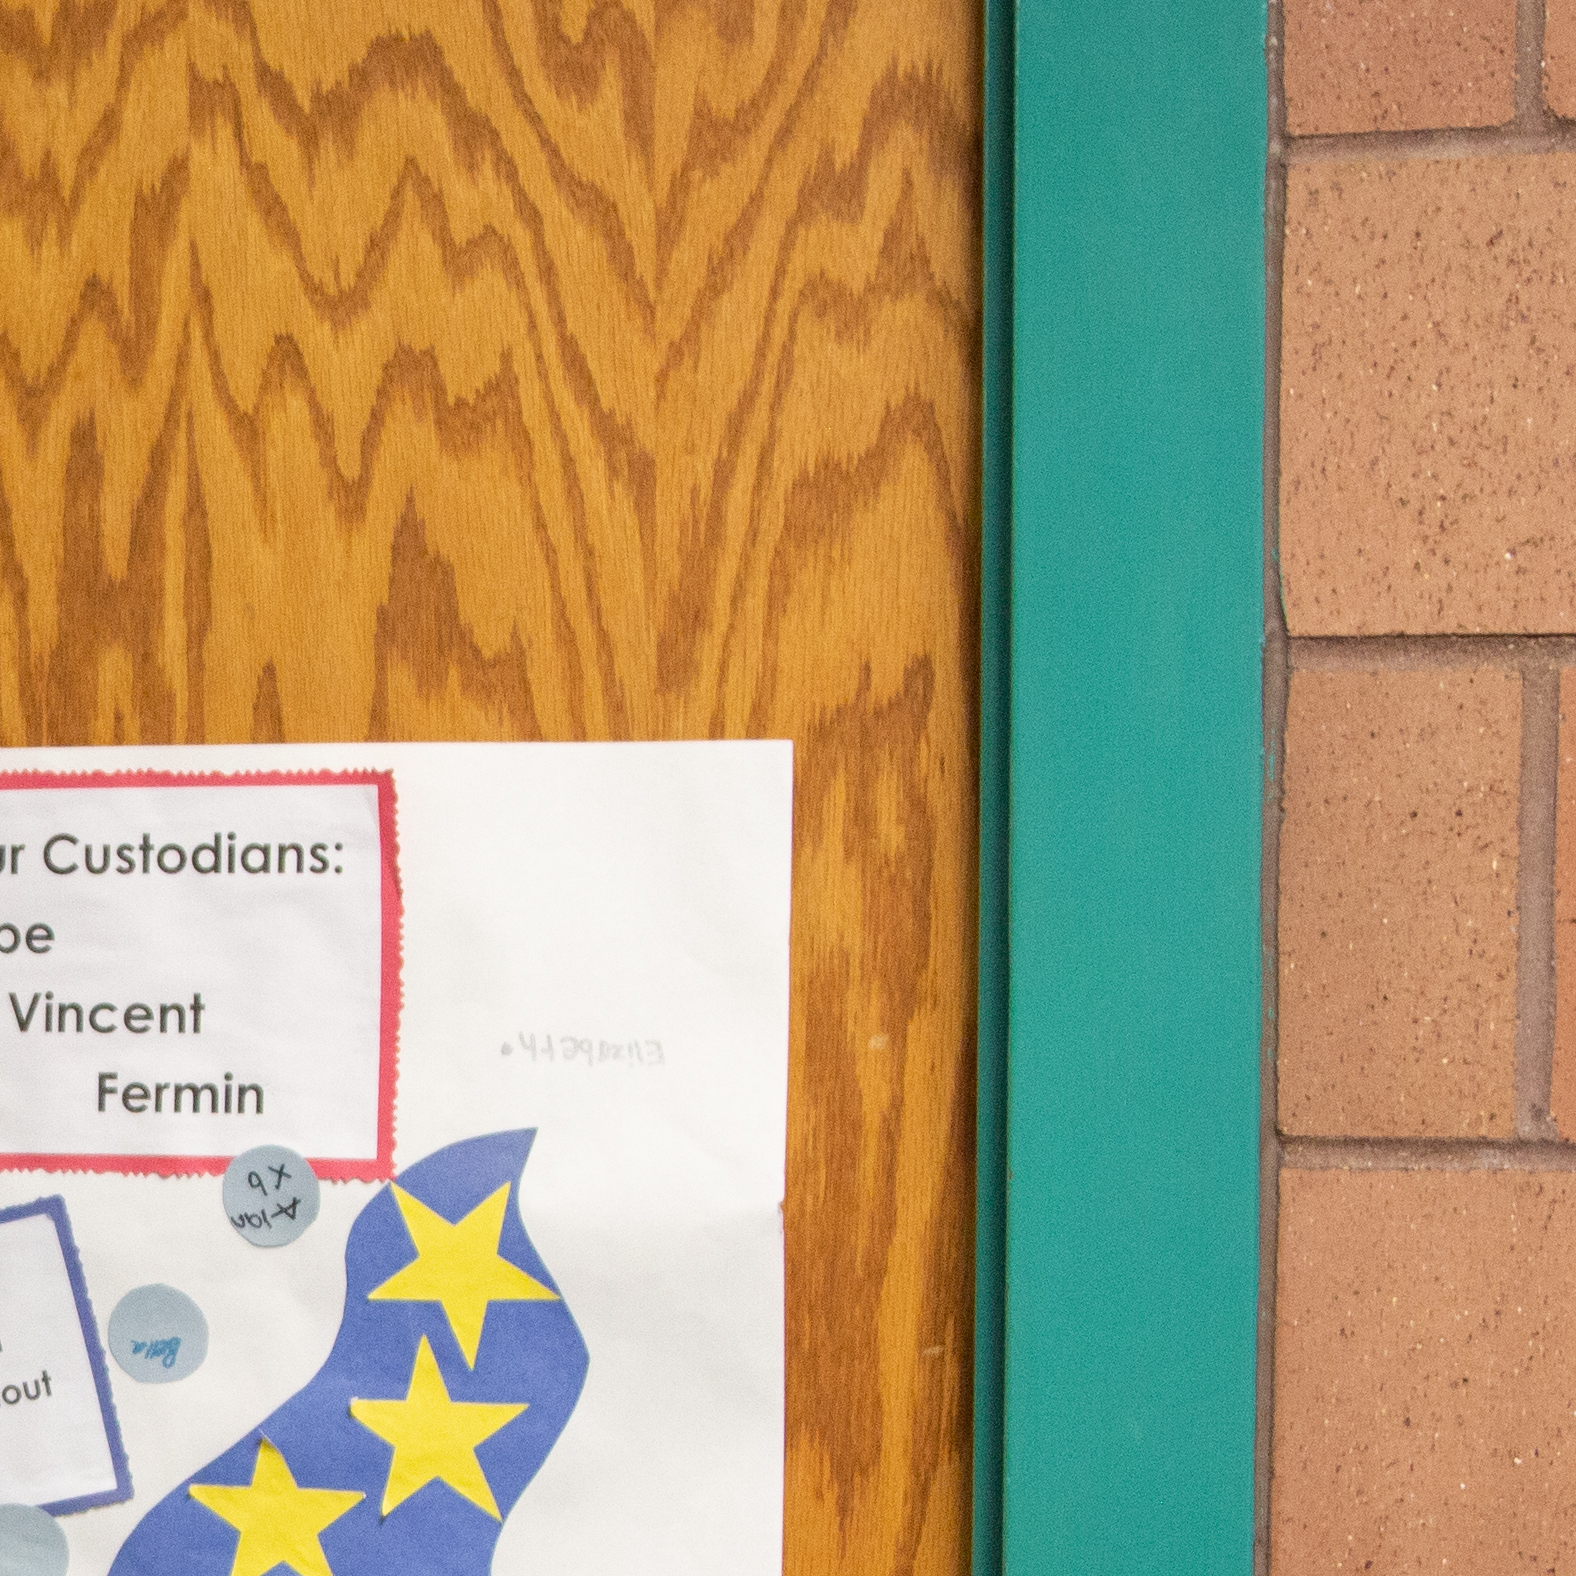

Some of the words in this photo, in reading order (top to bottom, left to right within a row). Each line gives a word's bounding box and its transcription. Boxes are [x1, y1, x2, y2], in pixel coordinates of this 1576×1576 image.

[43, 831, 344, 876] Custodians:
[8, 990, 206, 1035] Vincent
[97, 1071, 265, 1115] Fermin
